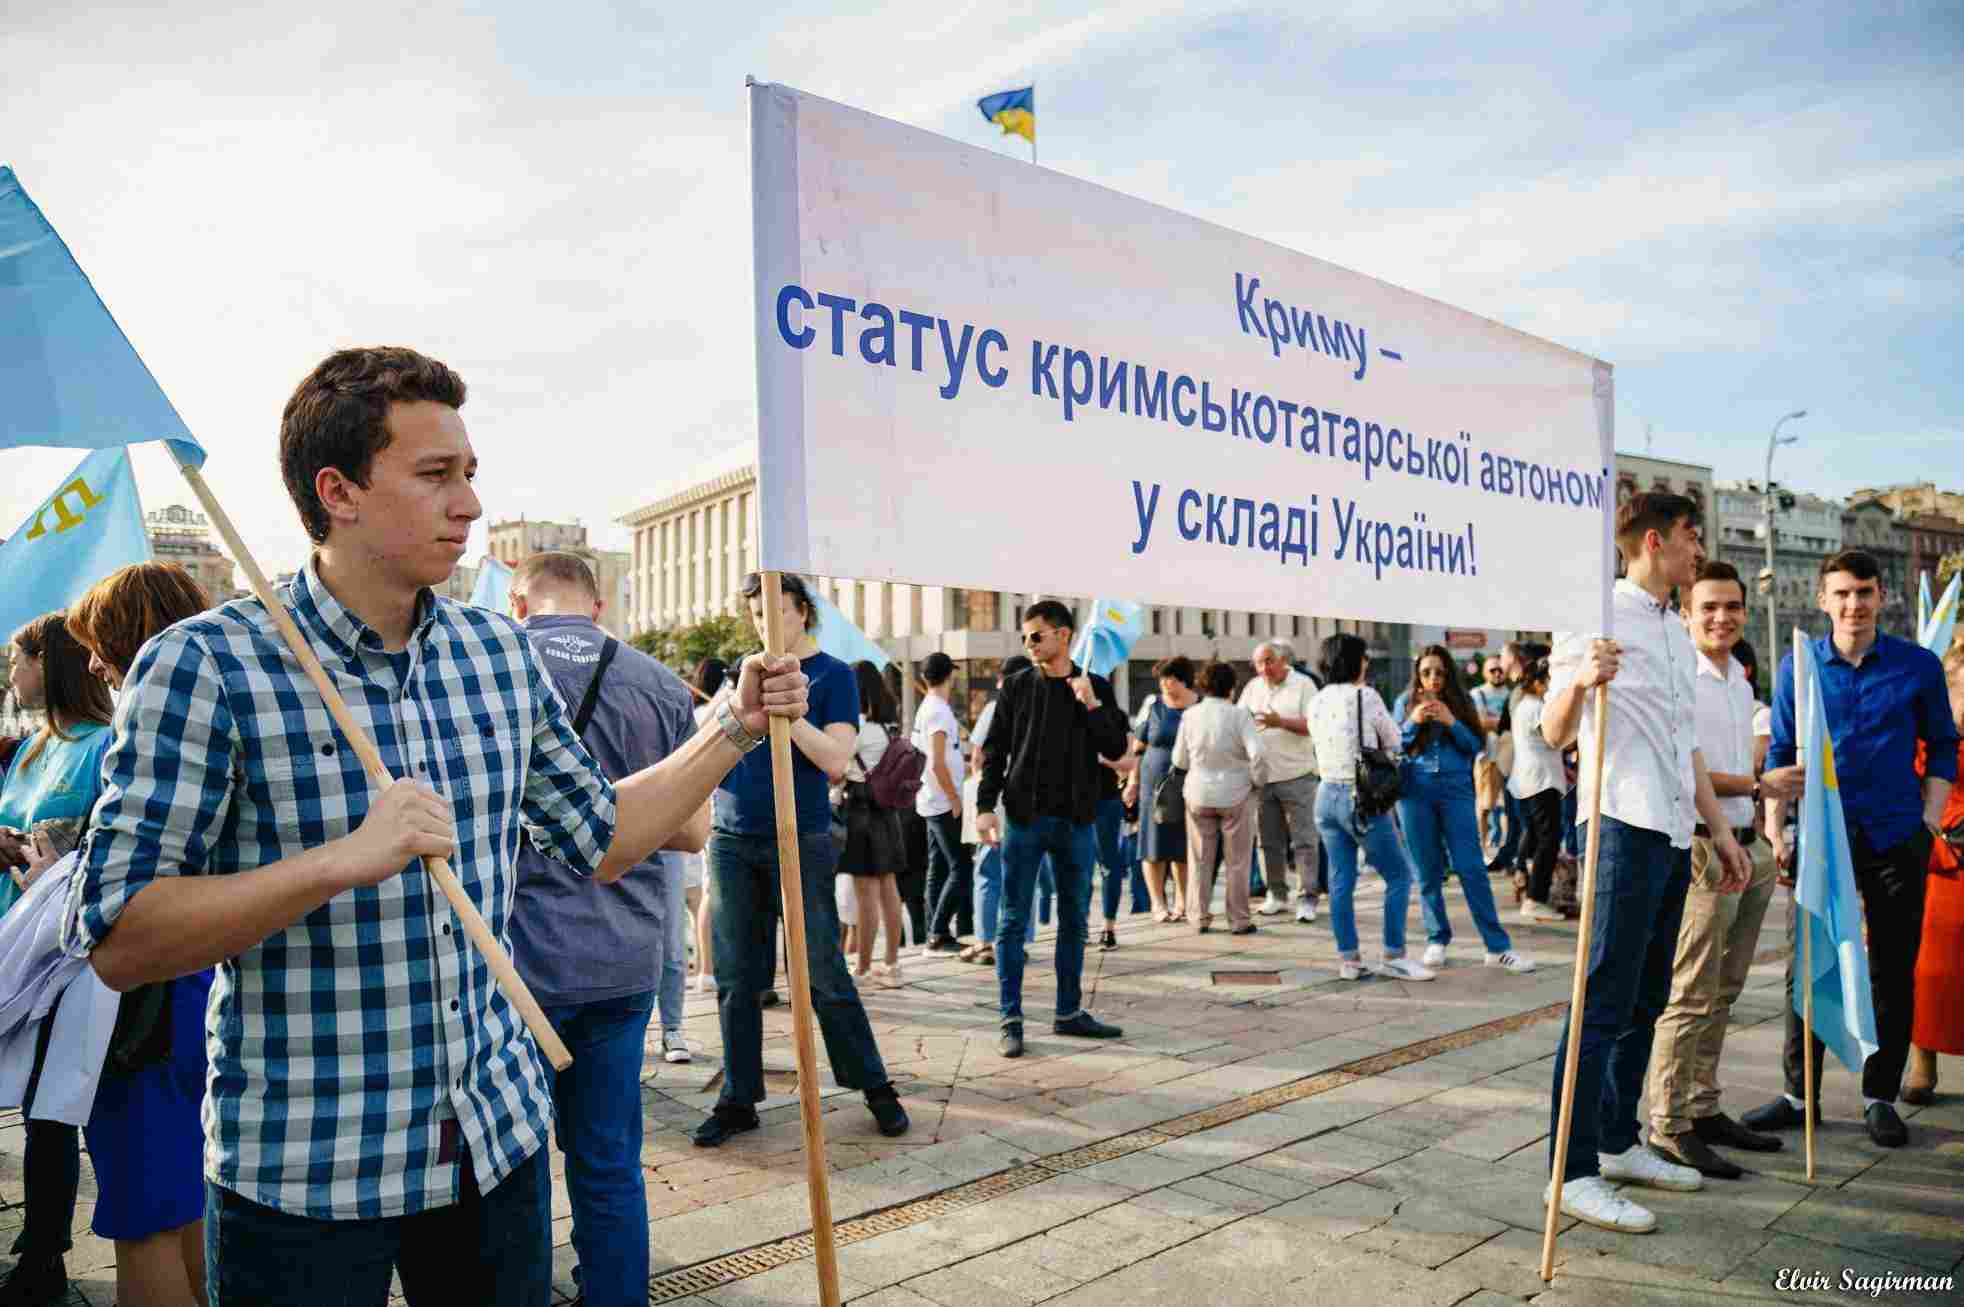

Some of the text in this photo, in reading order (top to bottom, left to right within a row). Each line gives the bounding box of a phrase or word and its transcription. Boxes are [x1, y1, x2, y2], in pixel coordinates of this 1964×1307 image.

[1234, 271, 1367, 381] Криму
[775, 283, 1010, 400] статус
[1031, 339, 1471, 487] кримськотатарської
[1177, 488, 1319, 567] складі
[1332, 497, 1478, 581] України!
